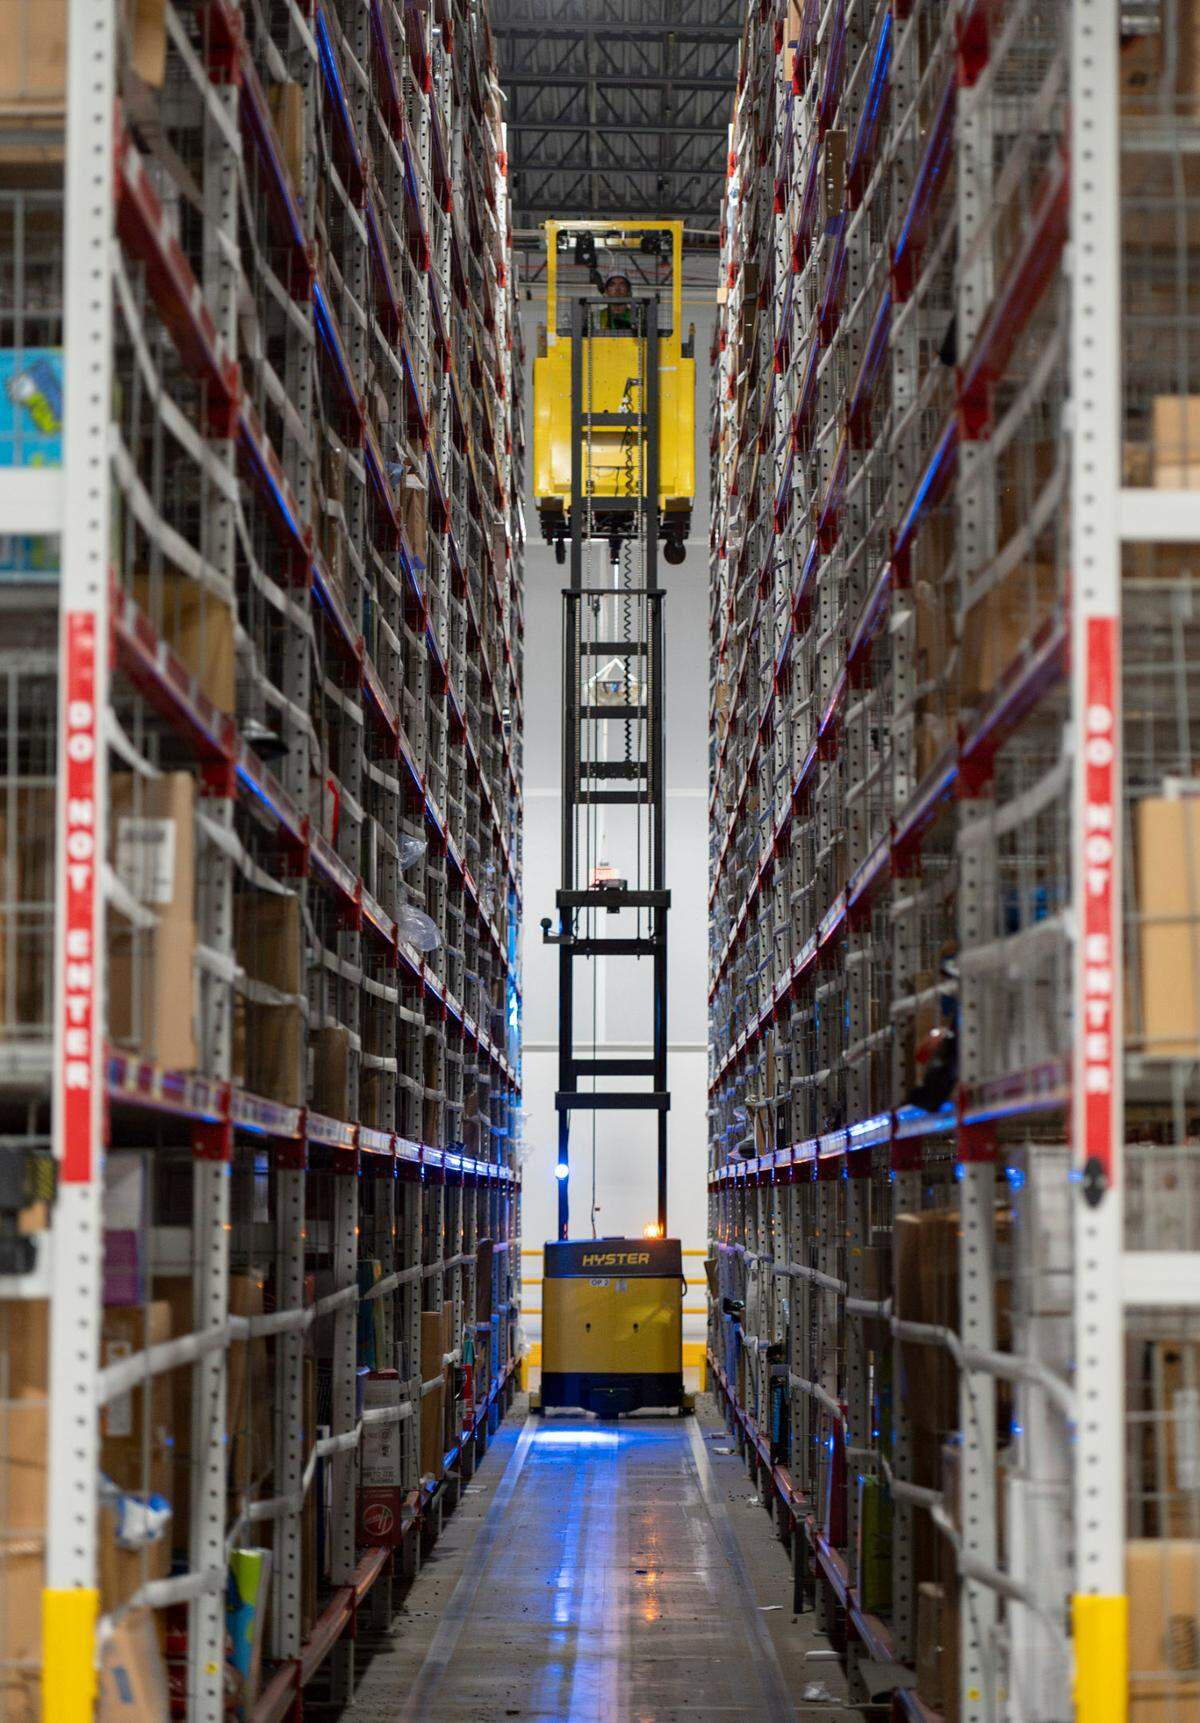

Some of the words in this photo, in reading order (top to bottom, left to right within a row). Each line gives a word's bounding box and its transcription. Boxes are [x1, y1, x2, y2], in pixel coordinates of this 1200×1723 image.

[67, 701, 95, 763] DO
[1086, 704, 1113, 767] DO
[66, 799, 94, 893] NOT
[1086, 803, 1113, 896] NOT
[65, 928, 91, 1089] ENTER
[1085, 933, 1111, 1094] ENTER
[582, 1252, 650, 1266] HYSTER
